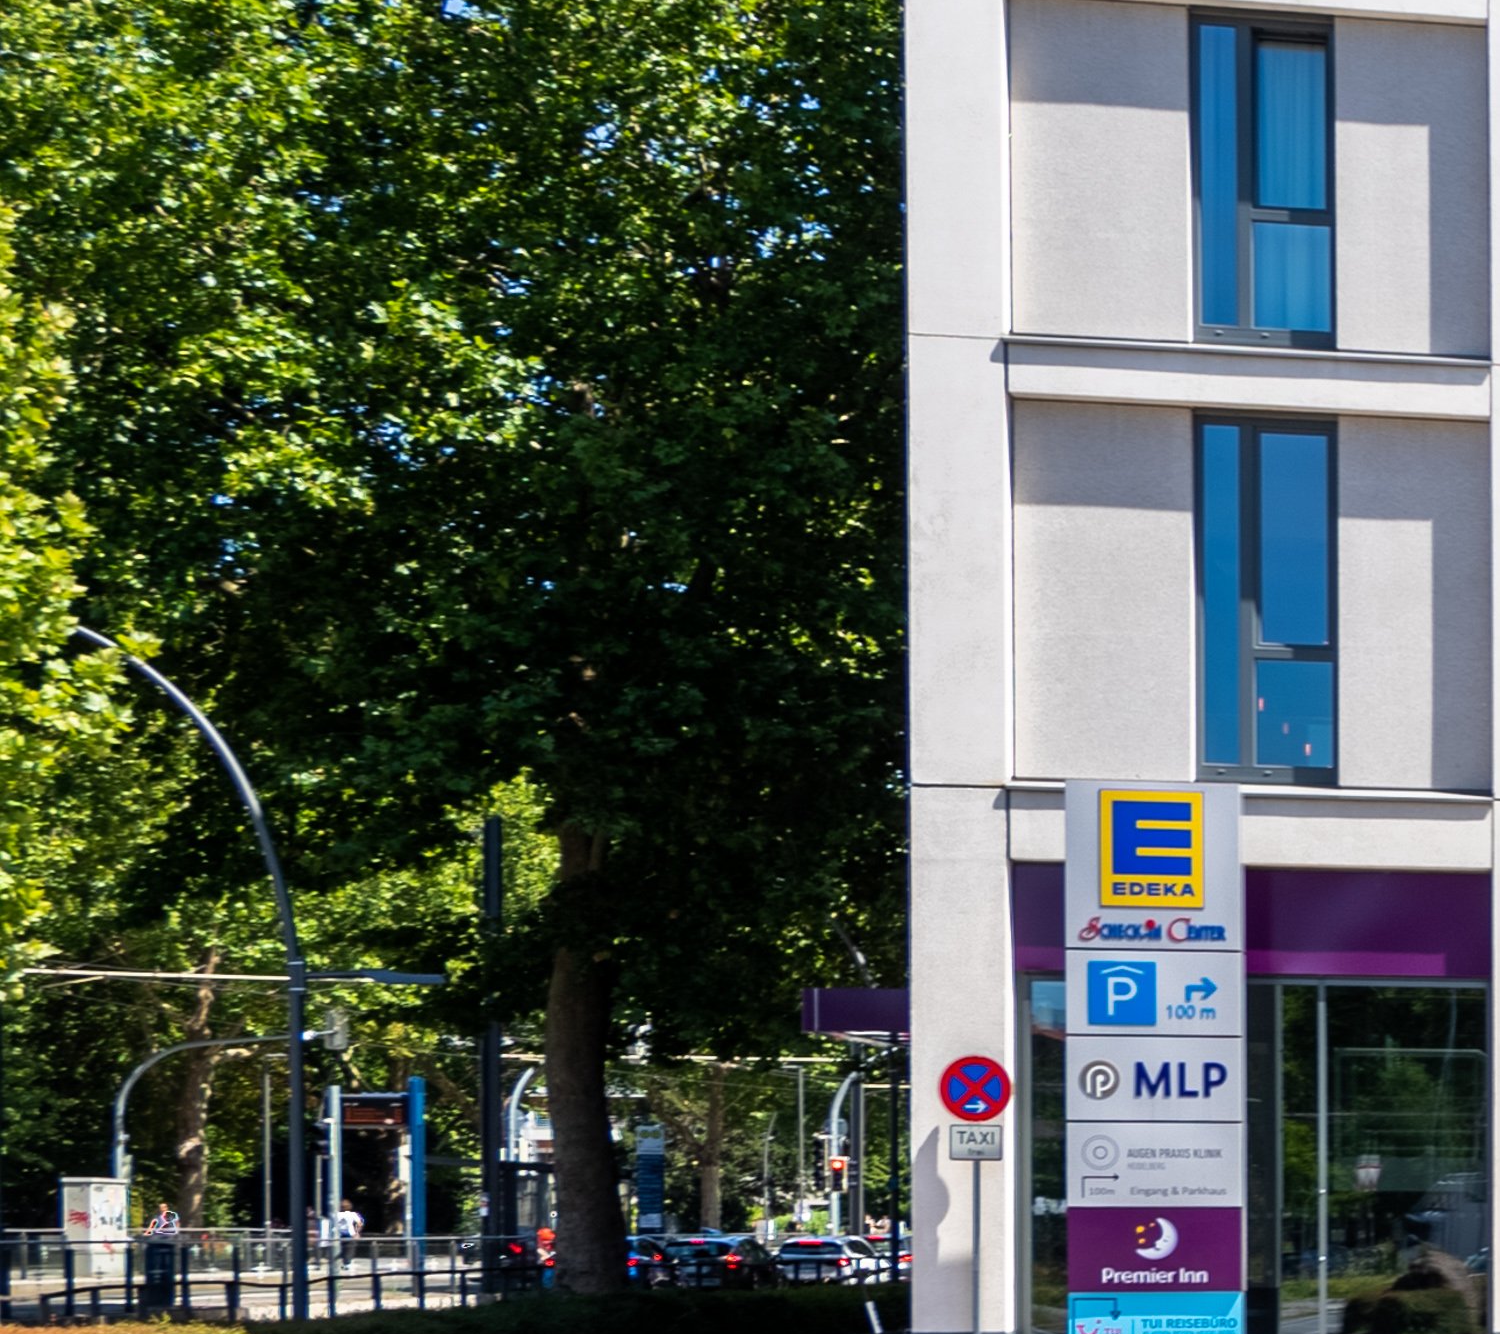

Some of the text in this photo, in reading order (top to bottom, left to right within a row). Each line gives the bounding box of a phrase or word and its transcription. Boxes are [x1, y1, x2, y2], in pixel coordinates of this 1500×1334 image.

[1112, 882, 1195, 896] EDEKA
[1107, 976, 1137, 1015] P
[1166, 1005, 1216, 1020] 100 m
[1133, 1061, 1228, 1099] MLP
[956, 1131, 996, 1145] TAXI
[1127, 1148, 1223, 1159] AUGEN PRAXIS KLINIK
[1129, 1186, 1169, 1198] Eingang
[1181, 1186, 1227, 1196] Parkhaus
[1101, 1267, 1209, 1284] Premier Inn
[1141, 1316, 1238, 1329] TUI REISEBÜRO
